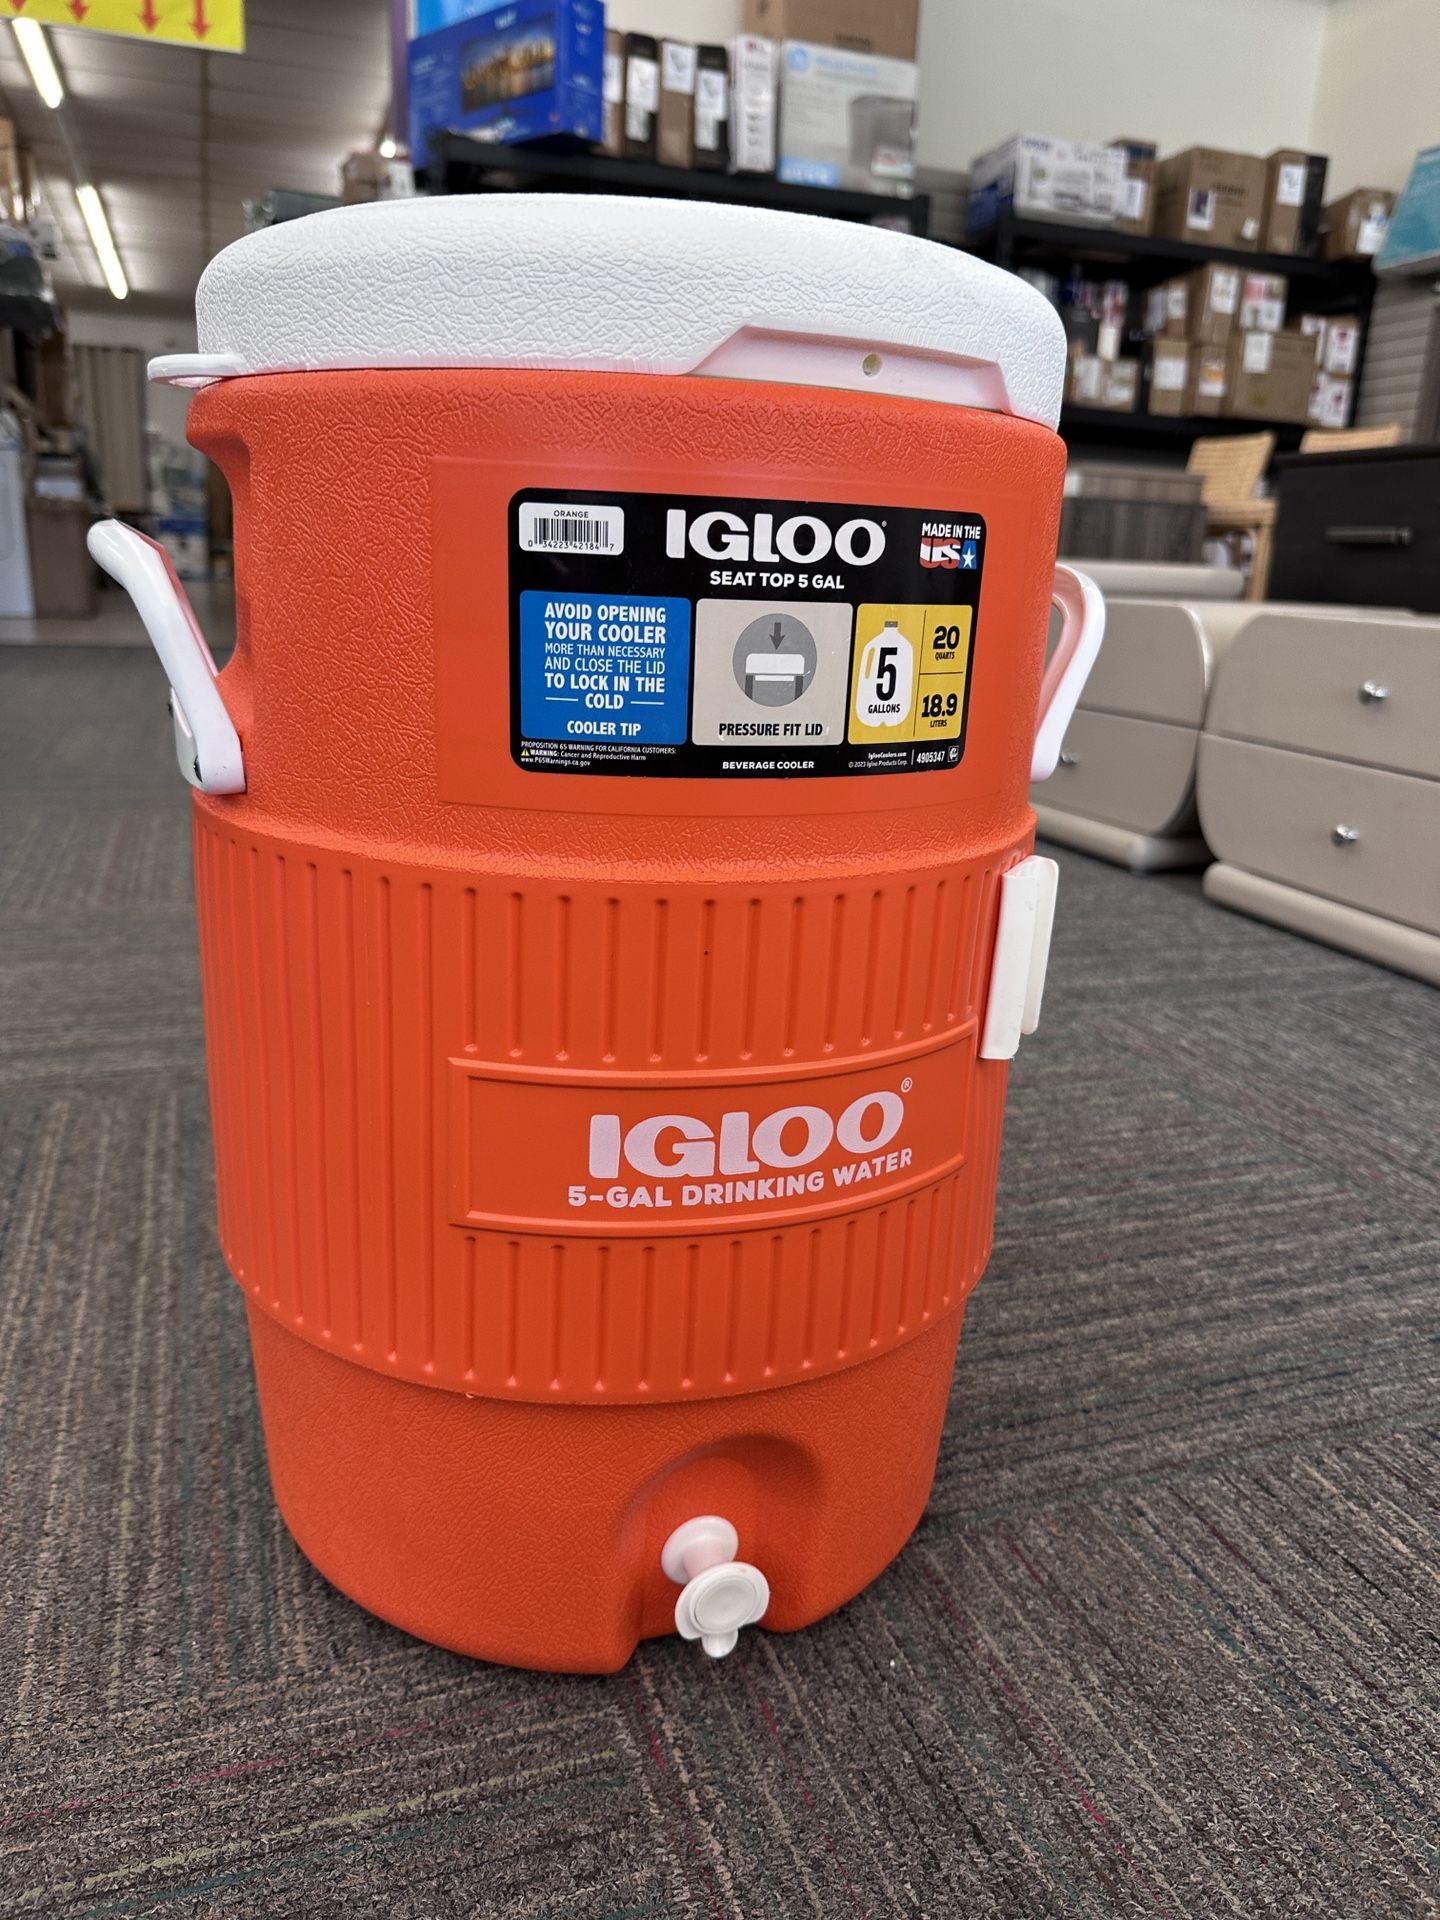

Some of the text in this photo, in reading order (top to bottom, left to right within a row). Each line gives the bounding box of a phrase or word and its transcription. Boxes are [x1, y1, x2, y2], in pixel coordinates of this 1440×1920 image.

[554, 510, 589, 518] ORANGE
[922, 523, 981, 539] MADE IN THE
[919, 537, 977, 569] USA
[710, 571, 845, 590] SEAT TOP 5 GAL
[545, 602, 666, 623] AVOID OPENING
[545, 621, 666, 644] YOUR COOLER
[933, 625, 960, 649] 20
[545, 643, 665, 659] MORE THAN NECESSARY
[935, 652, 955, 661] QUARTS
[545, 657, 665, 674] AND CLOSE THE LID
[876, 647, 898, 701] 5
[545, 673, 665, 693] TO LOCK IN THE
[585, 693, 624, 709] COLD
[868, 704, 900, 714] GALLONS
[921, 693, 958, 717] 18.9
[567, 720, 641, 736] COOLER TIP
[719, 723, 823, 736] PRESSURE FIT LID
[930, 719, 947, 728] LITERS
[521, 741, 558, 749] PROPOSITION
[568, 743, 594, 751] WARNING
[592, 752, 630, 761] Reproductive
[916, 751, 945, 763] 4905347
[722, 761, 815, 769] BEVERAGE COOLER
[568, 1148, 913, 1208] 5-GAL DRINKING WATER
